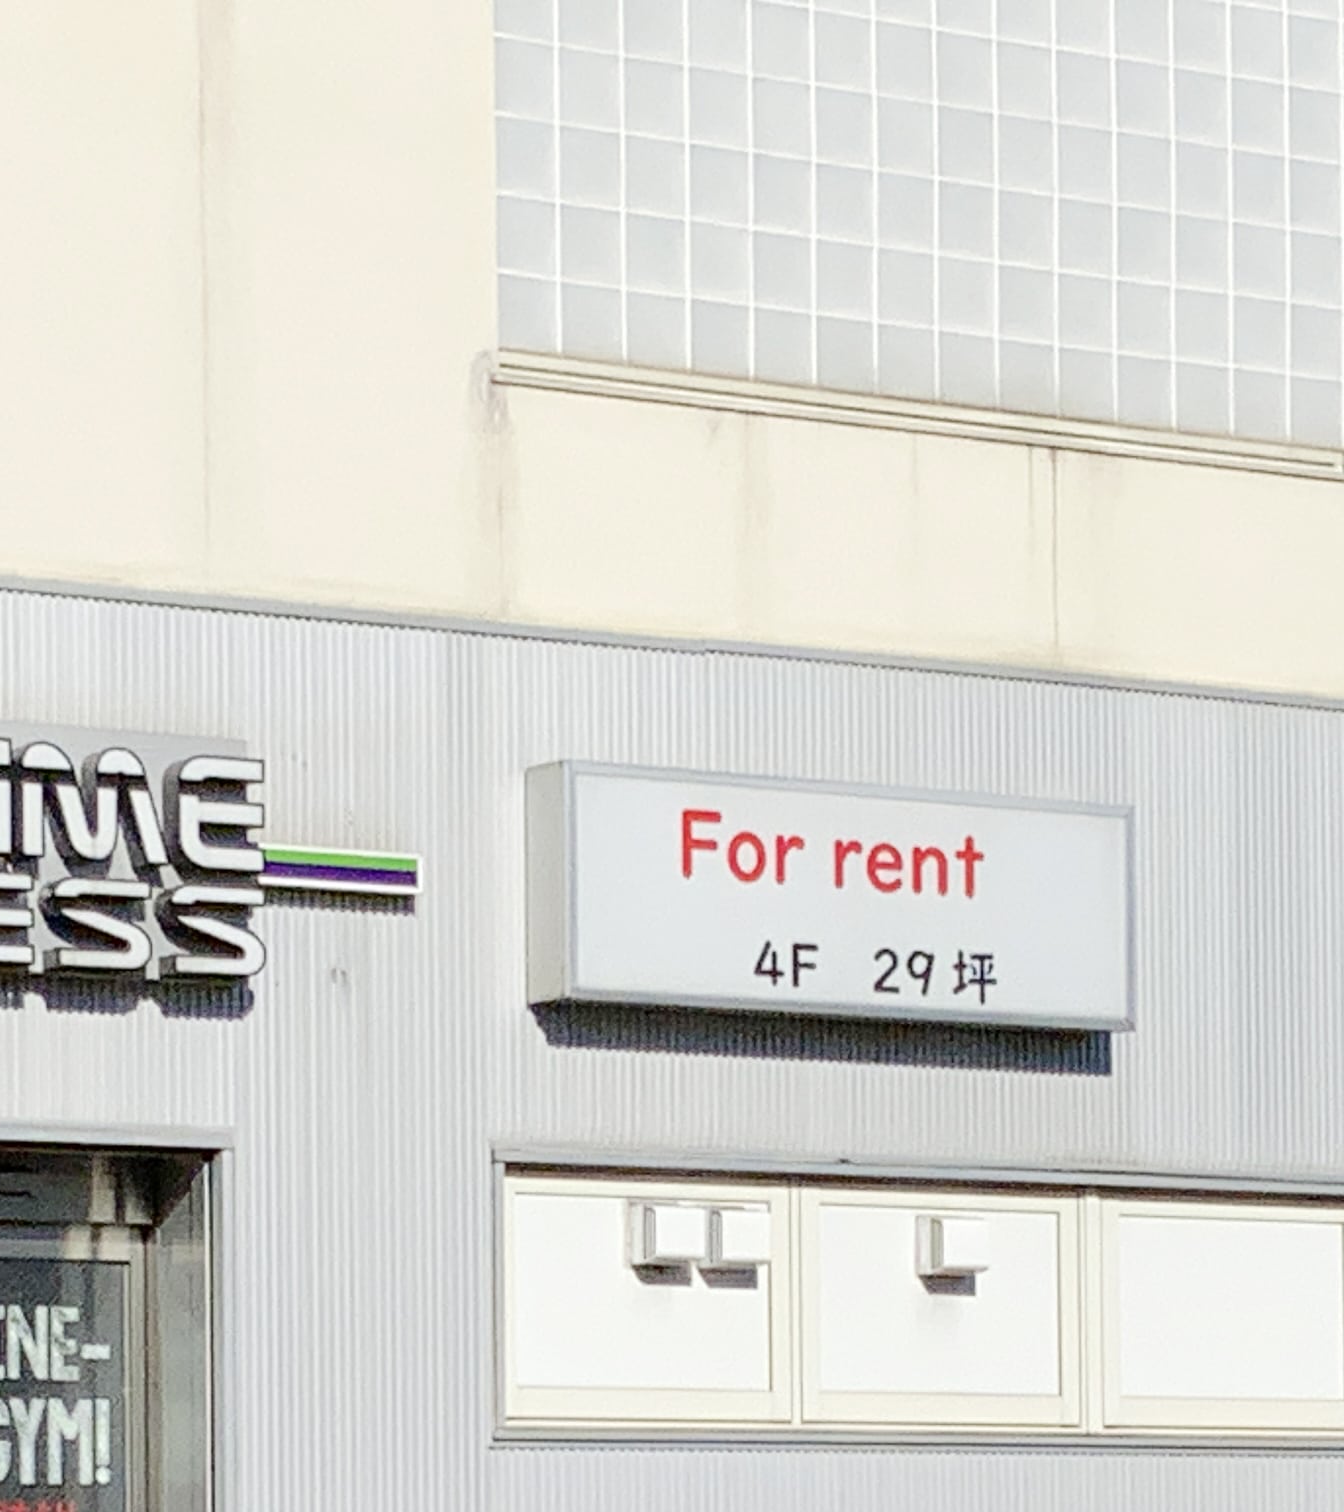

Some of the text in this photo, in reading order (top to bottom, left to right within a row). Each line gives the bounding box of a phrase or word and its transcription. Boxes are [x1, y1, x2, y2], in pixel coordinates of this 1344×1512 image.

[681, 808, 985, 898] For rent
[753, 940, 819, 988] 4F
